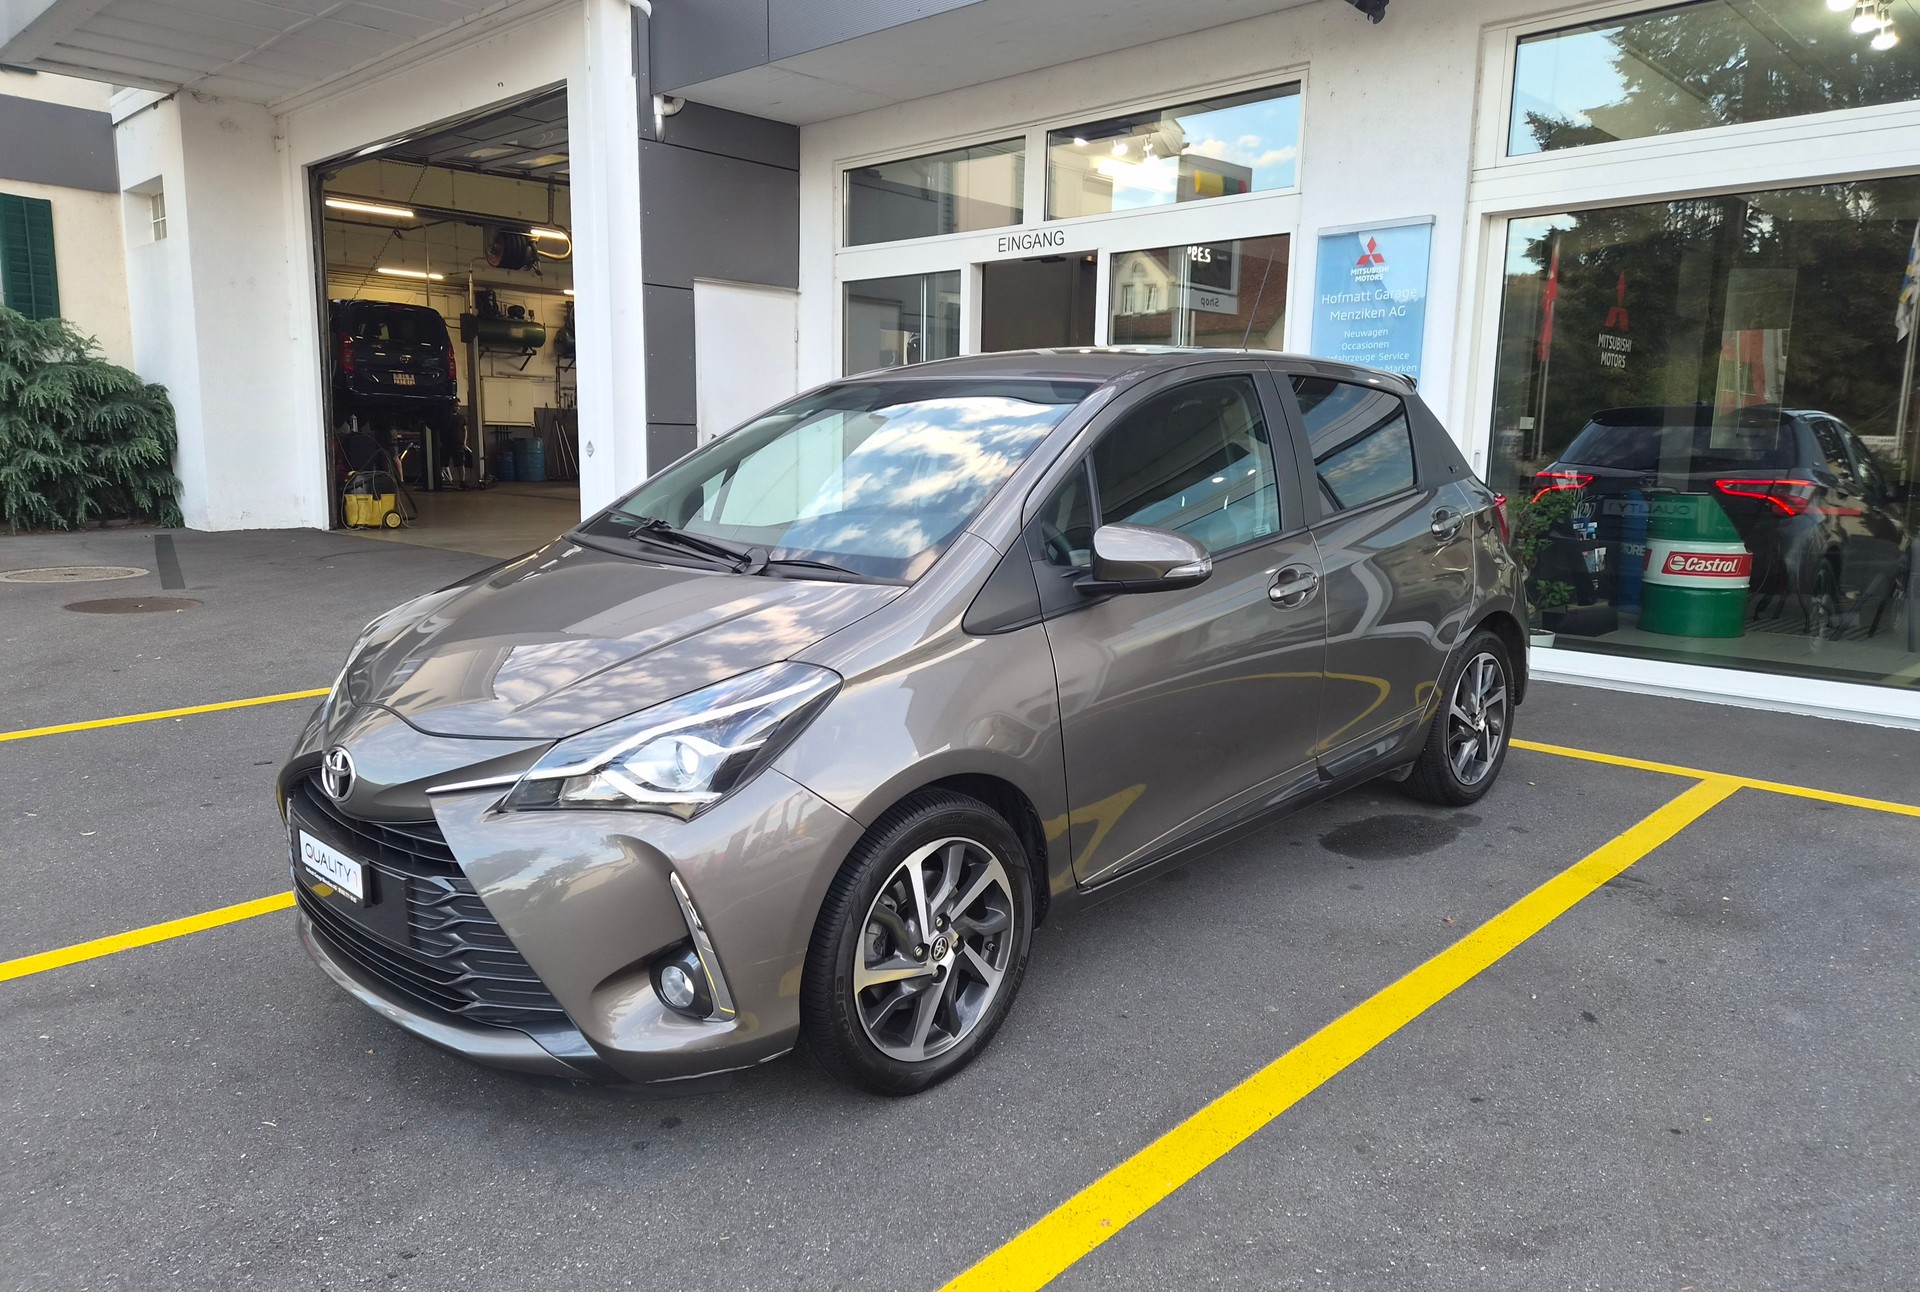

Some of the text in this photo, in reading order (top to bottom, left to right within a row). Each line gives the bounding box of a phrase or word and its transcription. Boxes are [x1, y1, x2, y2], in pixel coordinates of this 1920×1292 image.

[998, 230, 1065, 252] EINGANG
[1350, 266, 1390, 276] MITSUBISHI
[1355, 274, 1384, 283] MOTORS
[1321, 287, 1418, 305] Hofmatt Garage
[1330, 305, 1406, 321] Menziken AG
[1344, 328, 1389, 339] Neuwagen
[1341, 341, 1390, 351] Occasionen
[1597, 332, 1633, 353] MITSUBISHI
[1378, 352, 1410, 362] Service
[1600, 350, 1627, 369] MOTORS
[1385, 364, 1417, 373] Marken
[1683, 556, 1739, 573] Castrol
[305, 842, 351, 882] QUALITY
